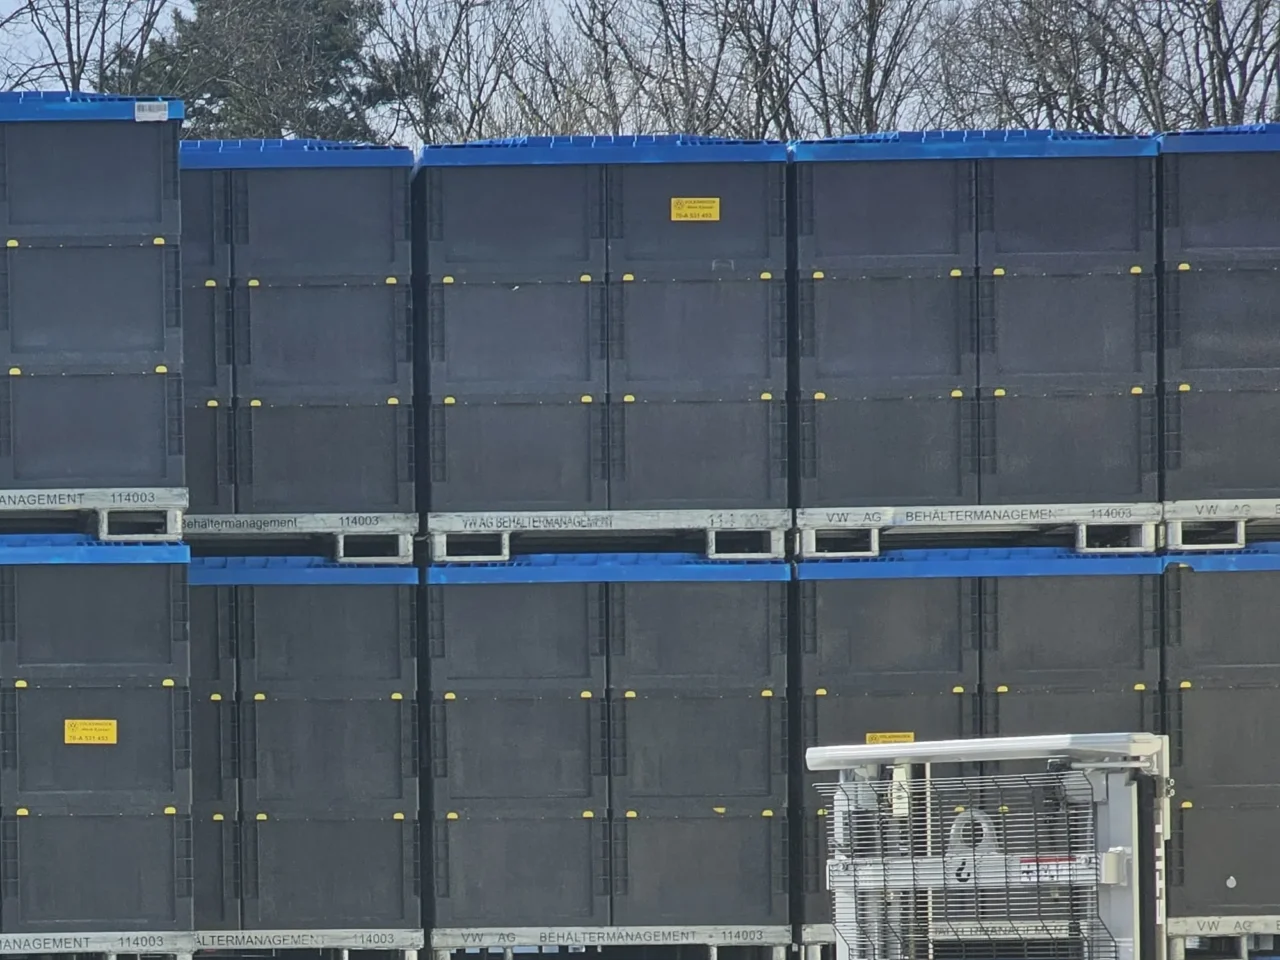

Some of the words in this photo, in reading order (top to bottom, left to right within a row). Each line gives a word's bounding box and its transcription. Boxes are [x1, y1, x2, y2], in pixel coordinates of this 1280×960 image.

[111, 492, 156, 504] 114003
[826, 512, 849, 522] VW
[863, 511, 882, 522] AG
[1090, 508, 1133, 519] 114003
[1195, 504, 1218, 515] VW
[339, 516, 379, 526] 114003
[1197, 921, 1220, 931] VW
[1234, 920, 1251, 931] AG
[118, 936, 164, 947] 114003
[353, 933, 395, 944] 114003
[461, 932, 484, 943] VW
[497, 932, 516, 943] AG
[721, 930, 764, 941] 114003
